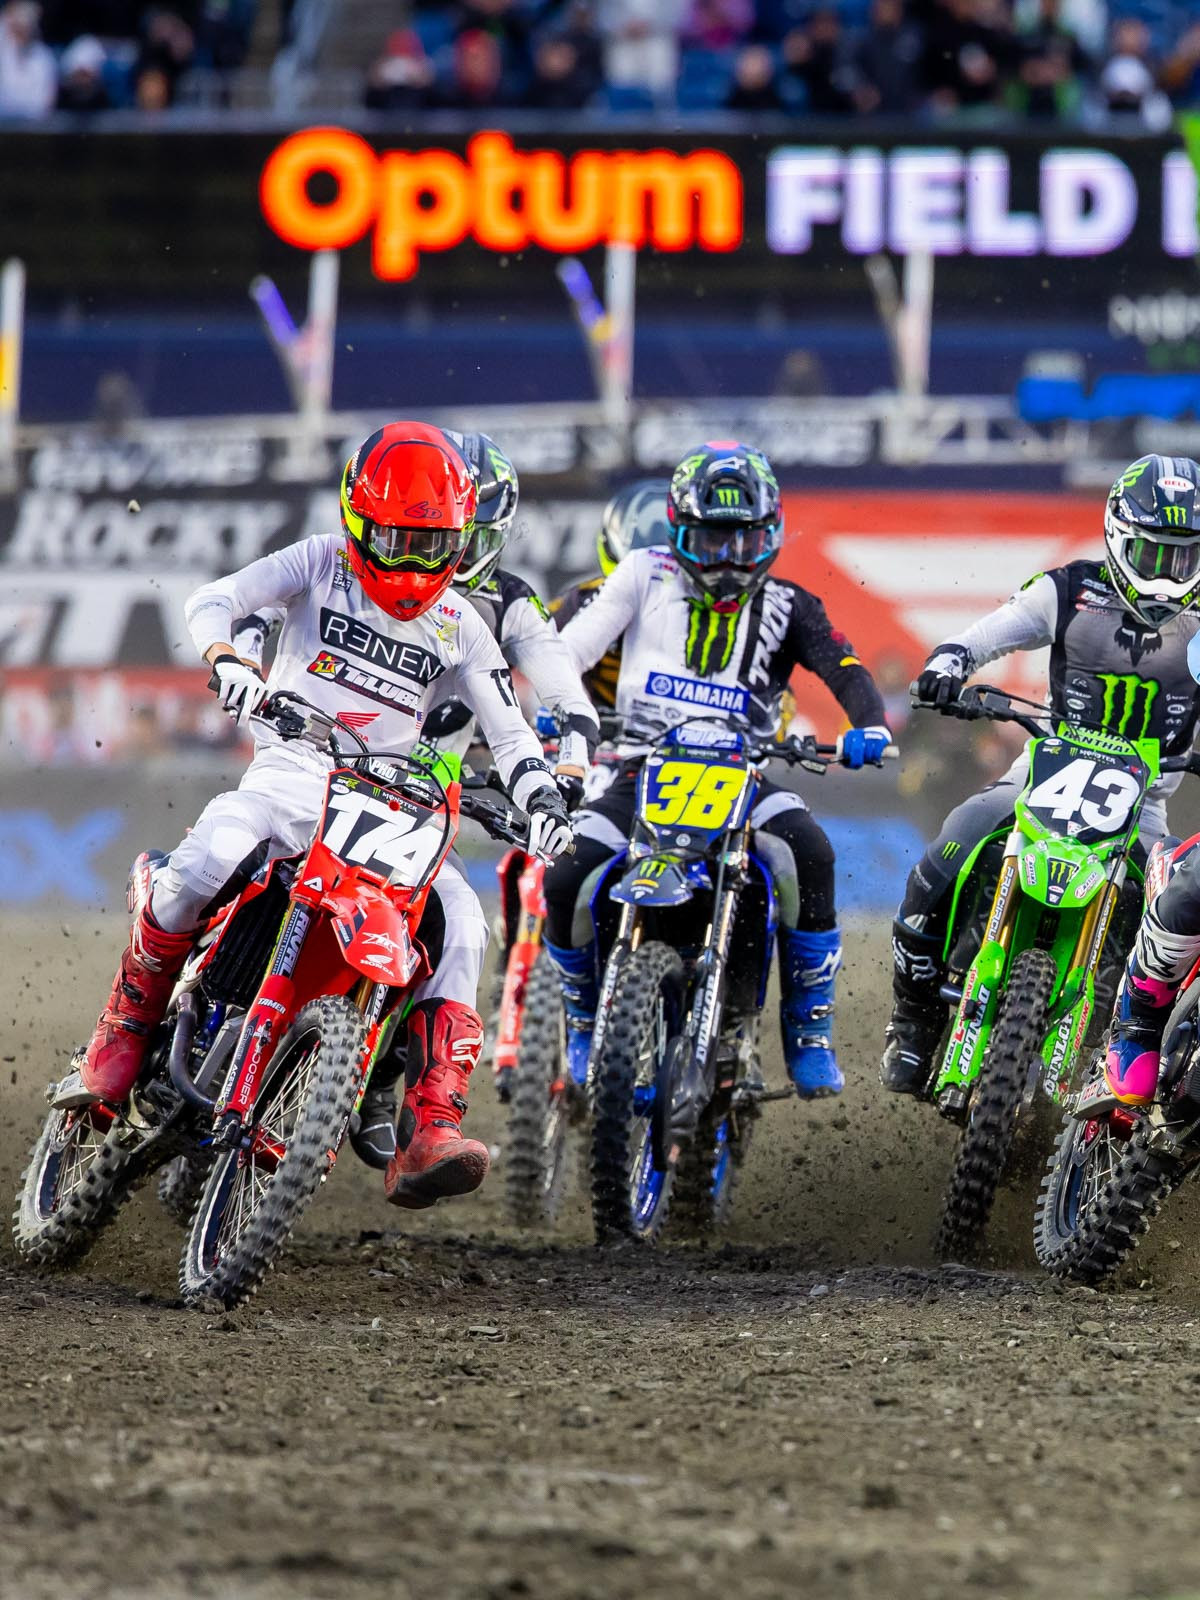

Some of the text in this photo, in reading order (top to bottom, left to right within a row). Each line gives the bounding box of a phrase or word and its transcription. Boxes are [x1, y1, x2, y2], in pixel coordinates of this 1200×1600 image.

[260, 126, 743, 281] Optum
[765, 147, 1138, 257] FIELD
[672, 679, 746, 713] YAMAHA
[382, 791, 419, 813] MONSTER
[646, 761, 747, 830] 38
[1027, 758, 1140, 833] 43
[322, 791, 443, 887] 174
[986, 866, 1016, 943] PRO CIRCUI
[281, 910, 311, 979] RIVAL
[360, 958, 395, 977] HONDA
[960, 984, 991, 1077] DUNLOP
[240, 1043, 265, 1106] OOSIER
